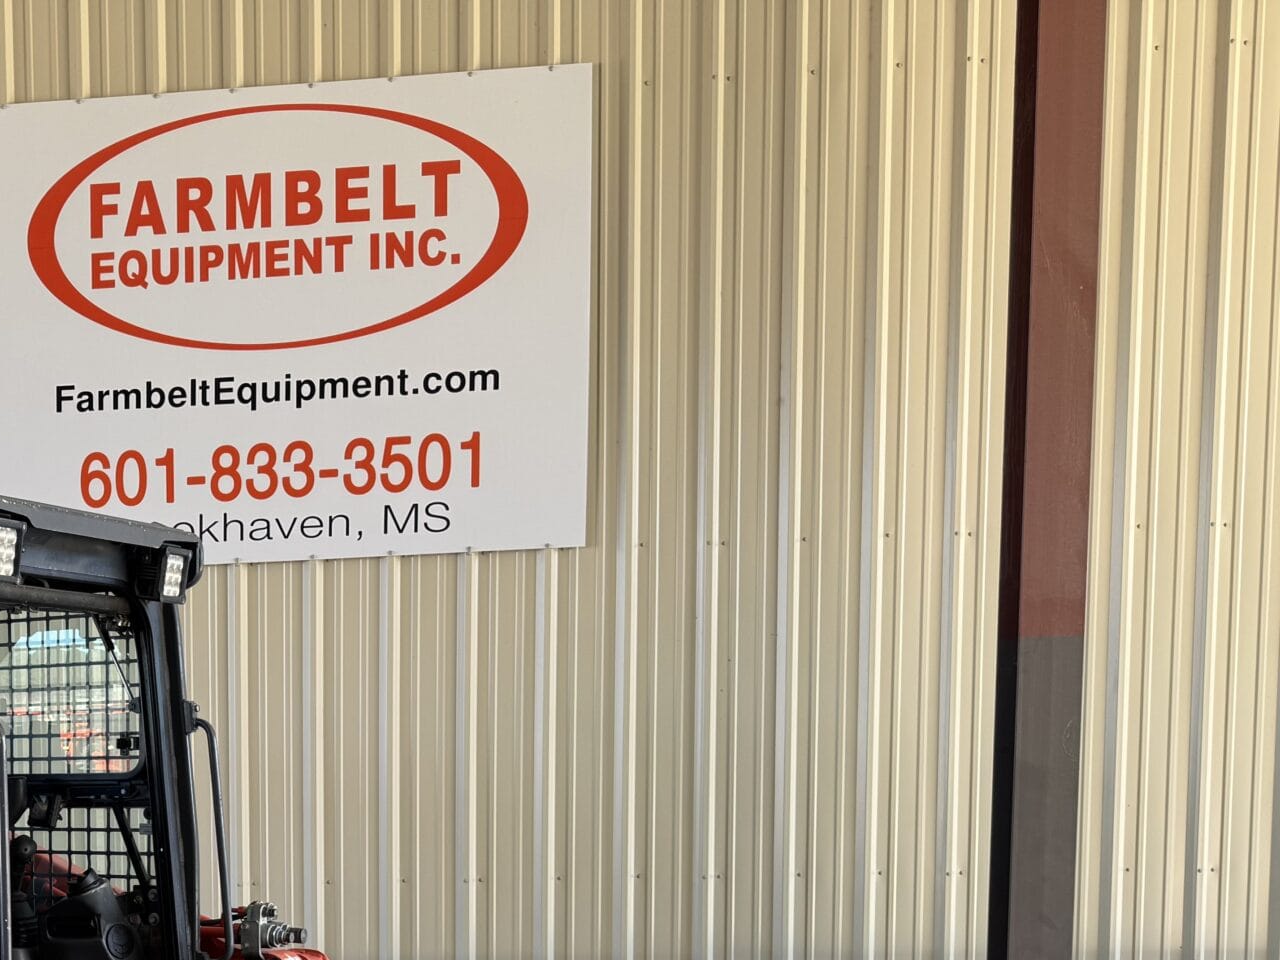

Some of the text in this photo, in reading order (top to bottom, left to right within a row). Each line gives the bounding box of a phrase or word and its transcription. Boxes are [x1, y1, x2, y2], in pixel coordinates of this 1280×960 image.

[89, 159, 462, 240] FARMBELT
[91, 228, 462, 290] EQUIPMENT INC.
[56, 369, 501, 414] FarmbeltEquipment.com
[79, 431, 482, 509] 601-833-3501
[383, 501, 452, 535] MS
